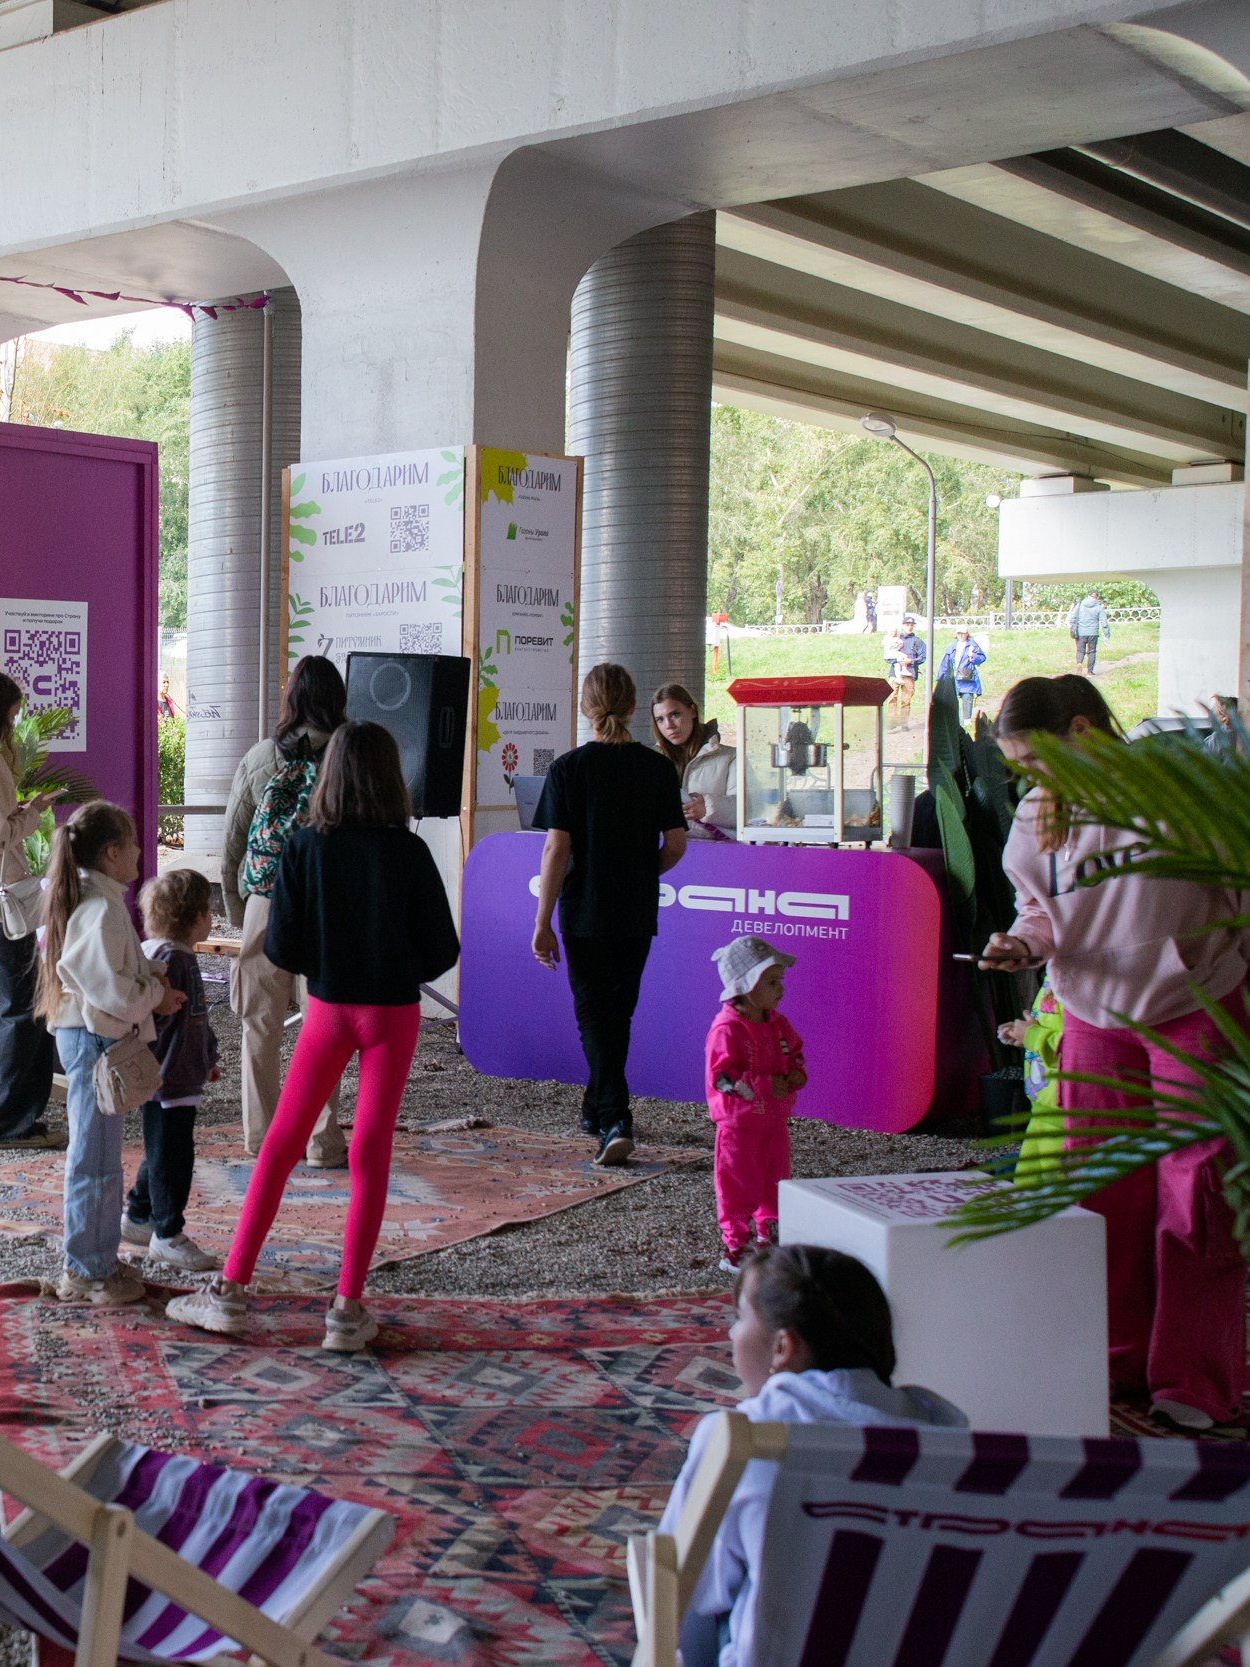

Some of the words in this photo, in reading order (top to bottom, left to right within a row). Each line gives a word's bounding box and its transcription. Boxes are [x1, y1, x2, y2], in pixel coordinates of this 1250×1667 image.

[321, 461, 429, 495] БЛАГОДАРИМ
[498, 465, 561, 492] БЛАГОДАРИМ
[322, 522, 366, 546] TELE2
[320, 580, 427, 608] БЛАГОДАРИМ
[496, 584, 559, 607] БЛАГОДАРИМ
[514, 635, 554, 647] ПОРЕВИТ
[495, 701, 557, 721] БЛАГОДАРИМ
[731, 919, 850, 940] ДЕВЕЛОПМЕНТ
